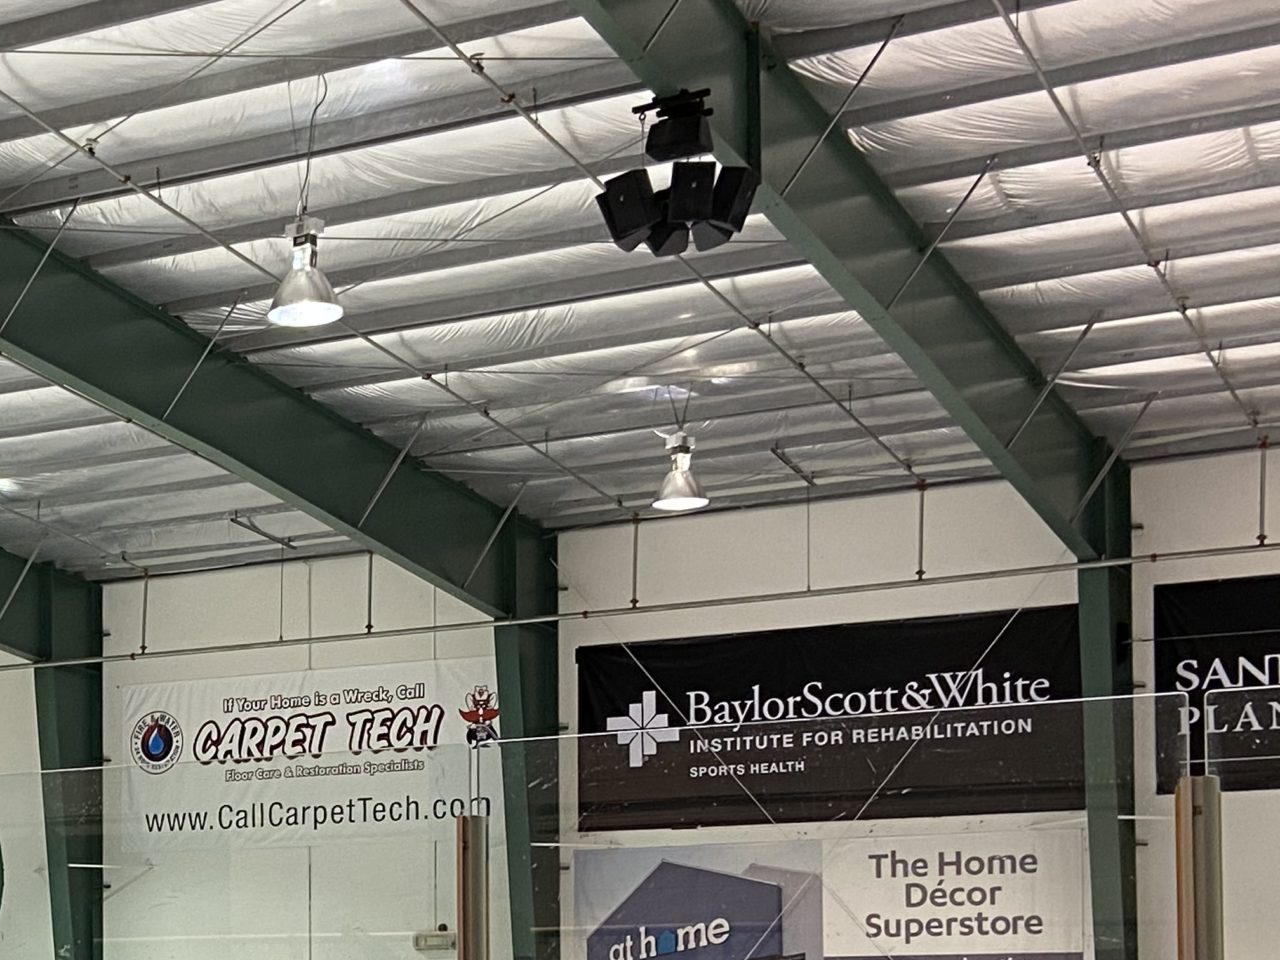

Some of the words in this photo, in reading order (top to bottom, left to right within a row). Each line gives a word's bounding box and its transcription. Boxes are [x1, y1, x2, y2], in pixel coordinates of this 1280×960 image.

[1175, 654, 1280, 692] SAN
[223, 699, 234, 713] If
[236, 698, 267, 712] Your
[270, 694, 310, 710] Home
[314, 691, 326, 706] is
[329, 693, 340, 705] a
[343, 687, 393, 704] Wreck,
[396, 683, 425, 699] Call
[193, 711, 337, 766] CARPET
[346, 703, 445, 756] TECH
[689, 734, 794, 754] INSTITUTE
[802, 729, 844, 747] FOR
[852, 717, 1033, 744] REHABILITATION
[225, 769, 254, 782] Floor
[255, 768, 282, 780] Care
[284, 766, 295, 778] &
[296, 763, 361, 778] Restoration
[363, 759, 425, 776] Specialists
[689, 764, 746, 778] SPORTS
[750, 760, 805, 774] HEALTH
[869, 850, 929, 879] The
[937, 850, 1039, 878] Home
[905, 879, 1003, 908] Décor
[865, 911, 1044, 944] Superstore
